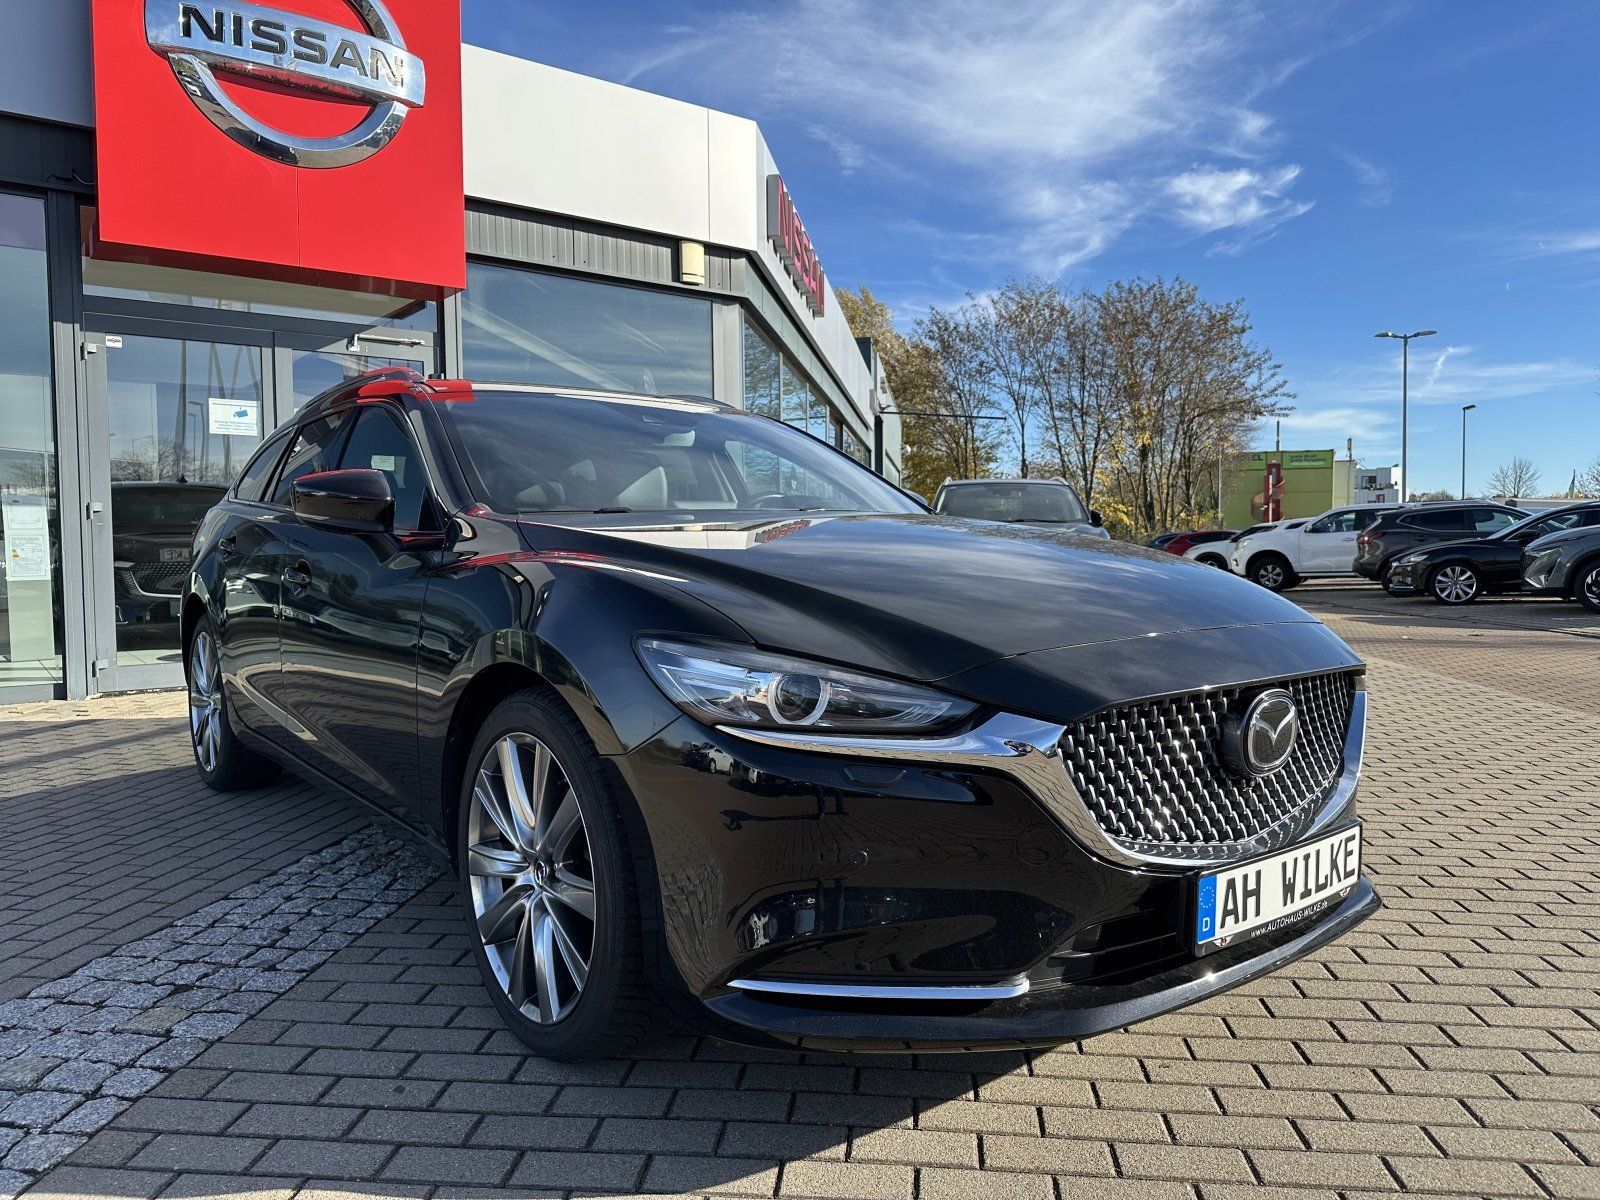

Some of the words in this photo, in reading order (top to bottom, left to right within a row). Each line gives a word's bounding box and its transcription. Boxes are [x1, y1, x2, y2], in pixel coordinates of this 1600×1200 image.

[179, 3, 404, 88] NISSAN
[772, 174, 825, 317] NISSAN
[1203, 917, 1210, 932] D
[1220, 868, 1261, 929] AH
[1281, 833, 1356, 908] WILKE
